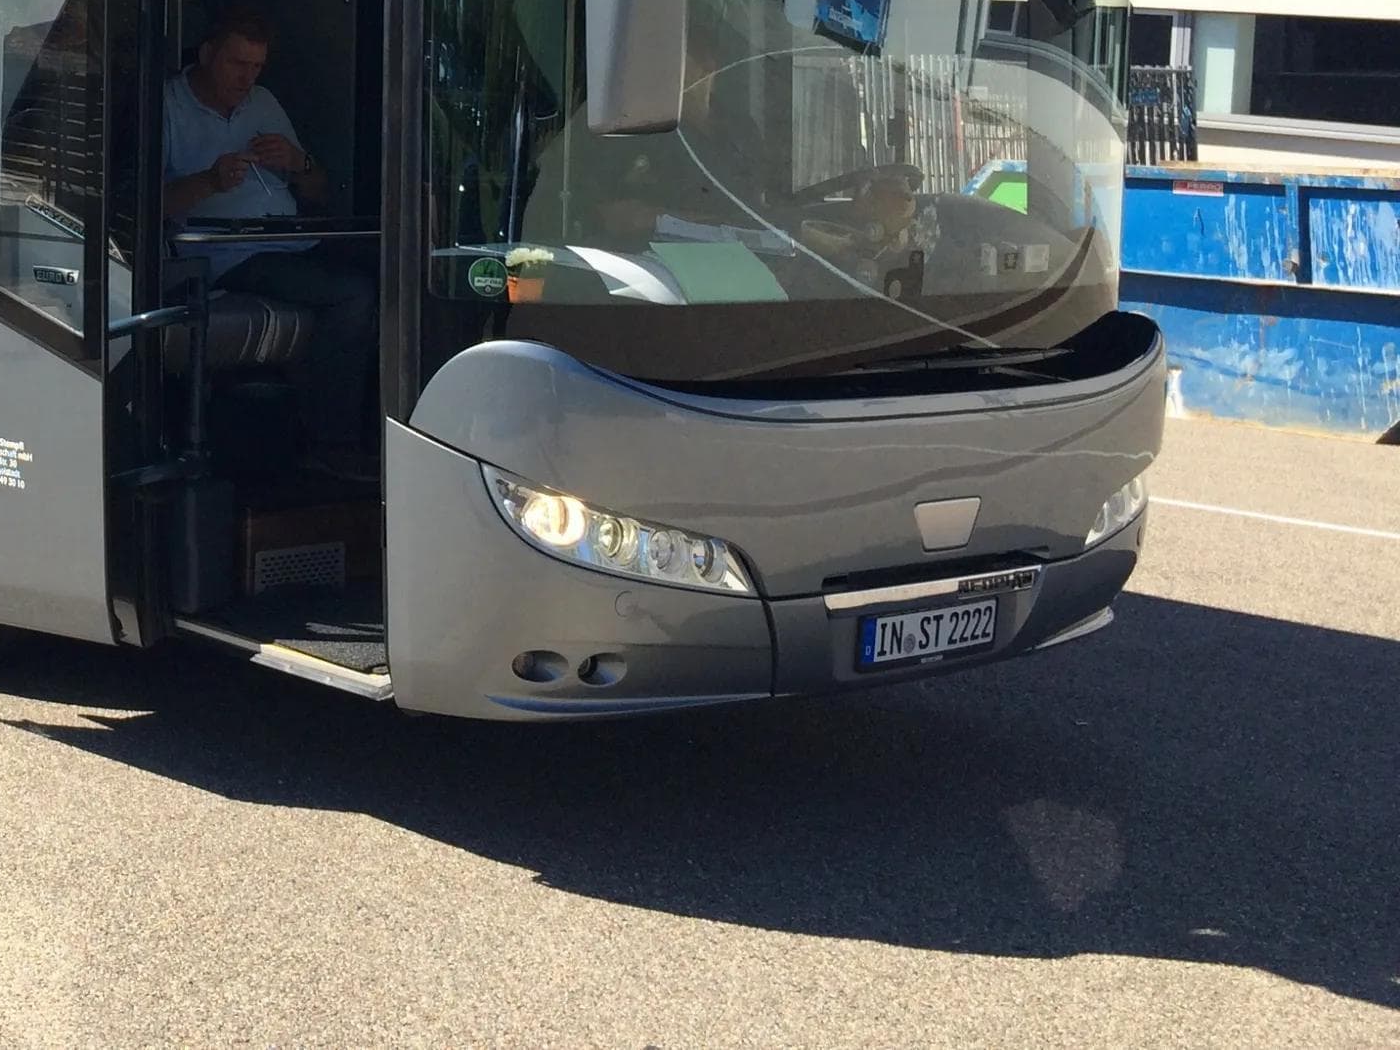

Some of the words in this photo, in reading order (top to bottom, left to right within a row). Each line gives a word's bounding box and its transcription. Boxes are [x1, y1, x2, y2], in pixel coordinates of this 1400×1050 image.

[36, 270, 62, 282] EURO
[67, 271, 75, 283] 6
[958, 571, 1034, 593] NEOPLAN
[877, 621, 904, 657] IN
[919, 614, 944, 650] ST
[947, 606, 993, 645] 2222
